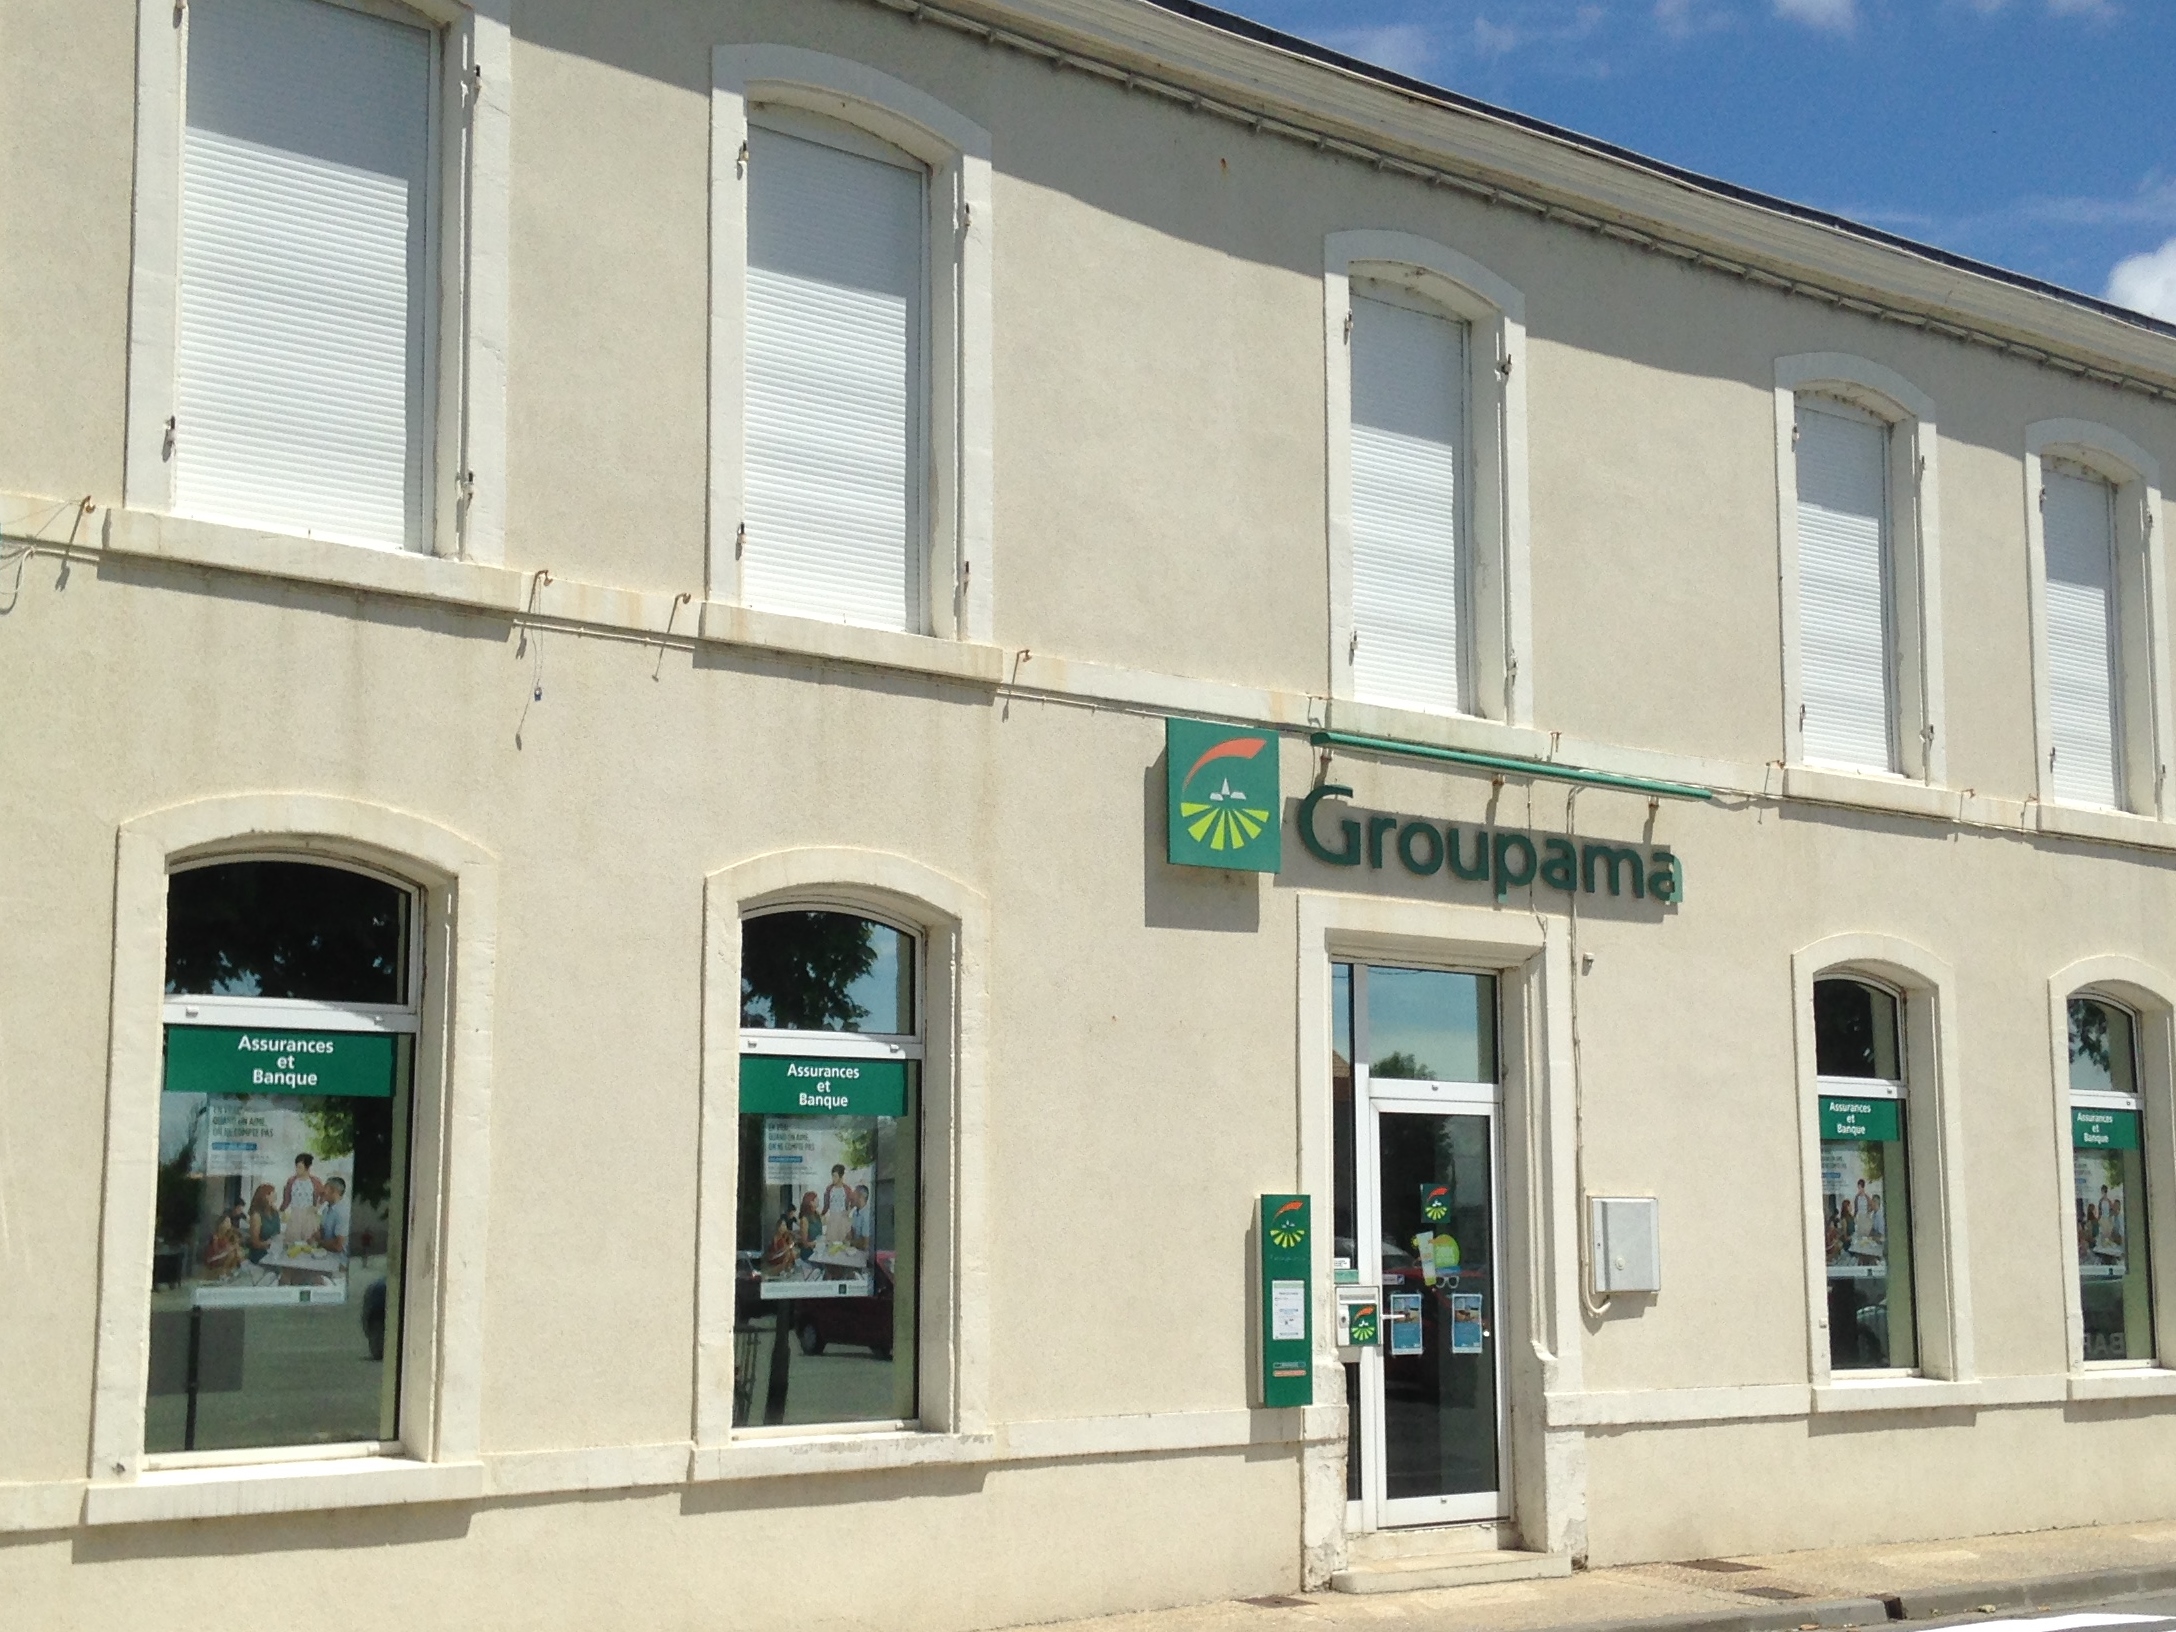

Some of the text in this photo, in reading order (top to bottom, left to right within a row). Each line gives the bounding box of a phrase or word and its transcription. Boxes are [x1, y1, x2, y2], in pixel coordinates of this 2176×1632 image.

[1298, 784, 1683, 905] Groupama
[238, 1034, 334, 1054] Assurances
[277, 1055, 295, 1069] et
[787, 1063, 860, 1079] Assurances
[253, 1069, 318, 1089] Banque
[816, 1081, 831, 1093] et
[799, 1093, 848, 1110] Banque
[1829, 1102, 1872, 1113] Assurances
[1846, 1114, 1856, 1124] et
[2077, 1112, 2113, 1123] Assurances
[1837, 1123, 1866, 1136] Banque
[2092, 1124, 2100, 1132] et
[2083, 1133, 2109, 1144] Banque
